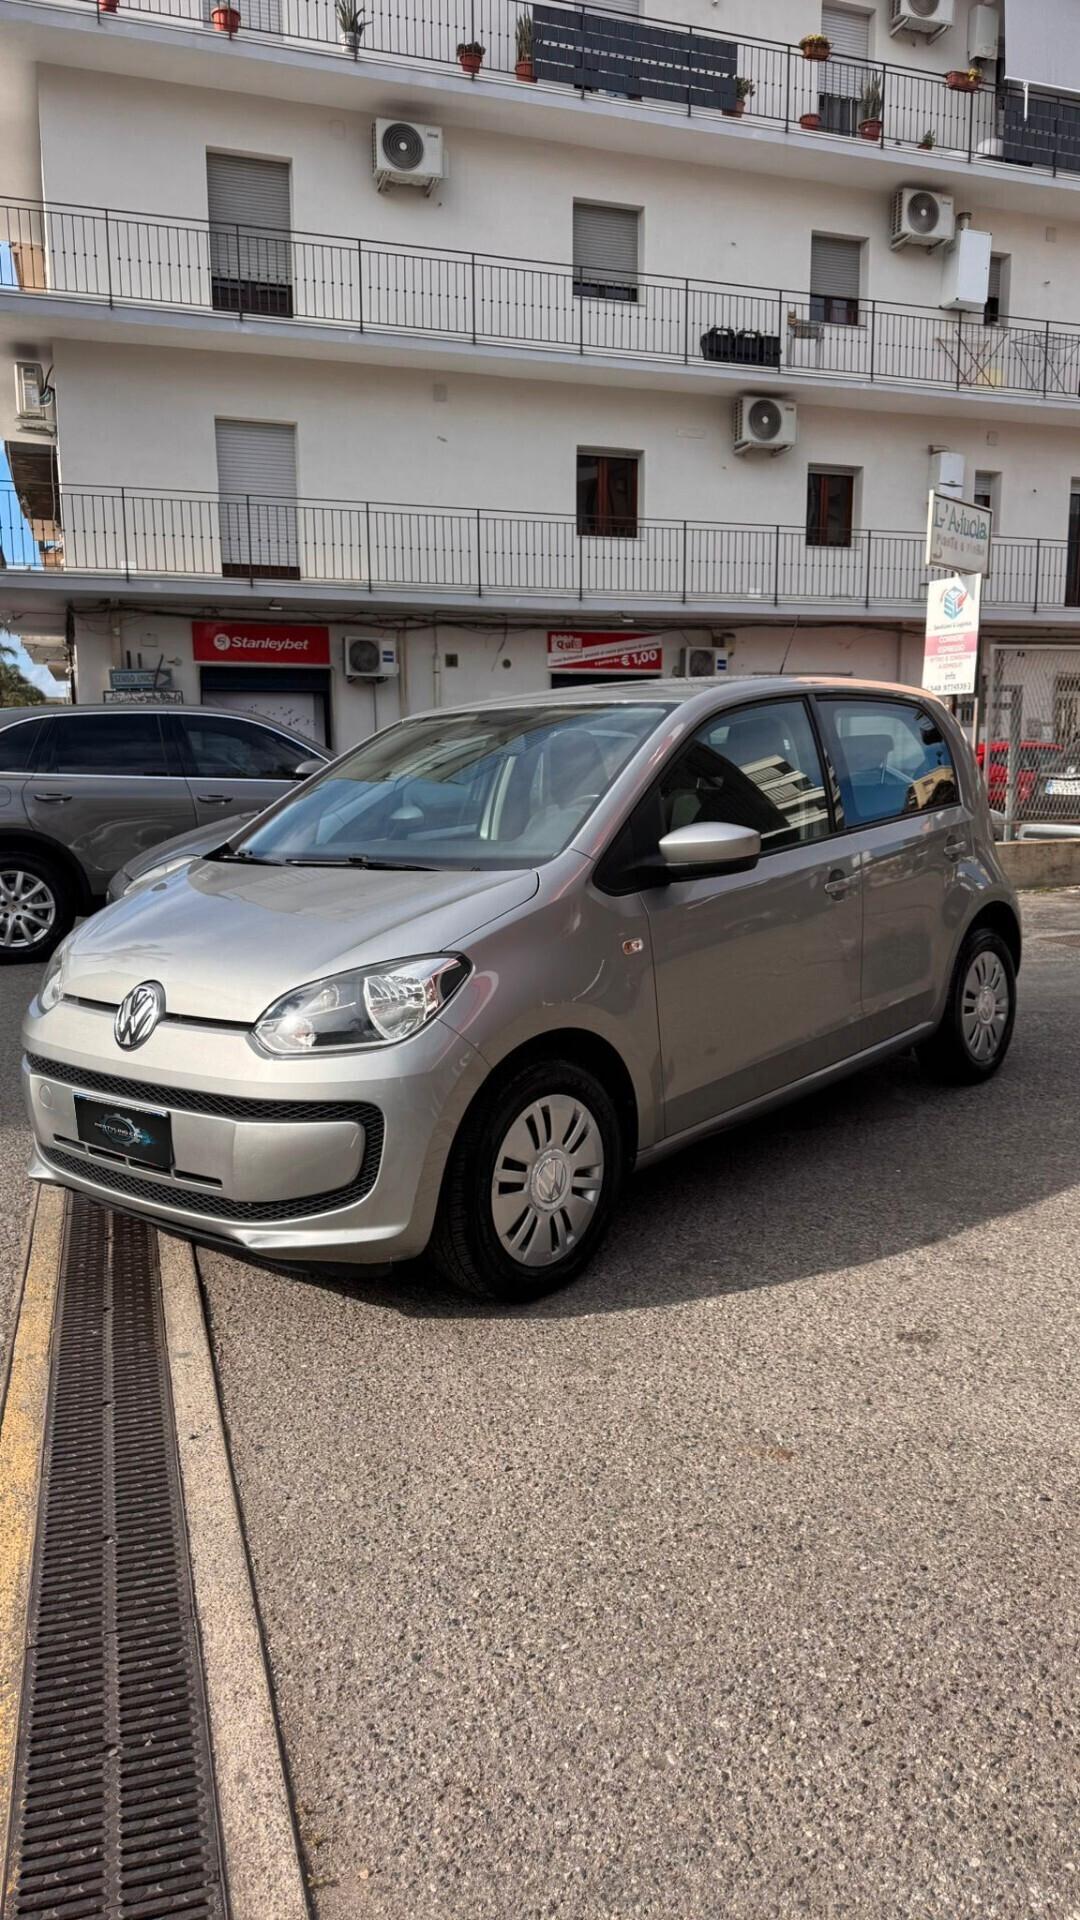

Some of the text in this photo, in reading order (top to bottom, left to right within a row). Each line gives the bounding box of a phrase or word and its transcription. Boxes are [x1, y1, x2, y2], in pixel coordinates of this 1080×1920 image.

[231, 636, 309, 651] Stanleybet
[621, 654, 630, 666] €
[631, 650, 658, 665] 1,00
